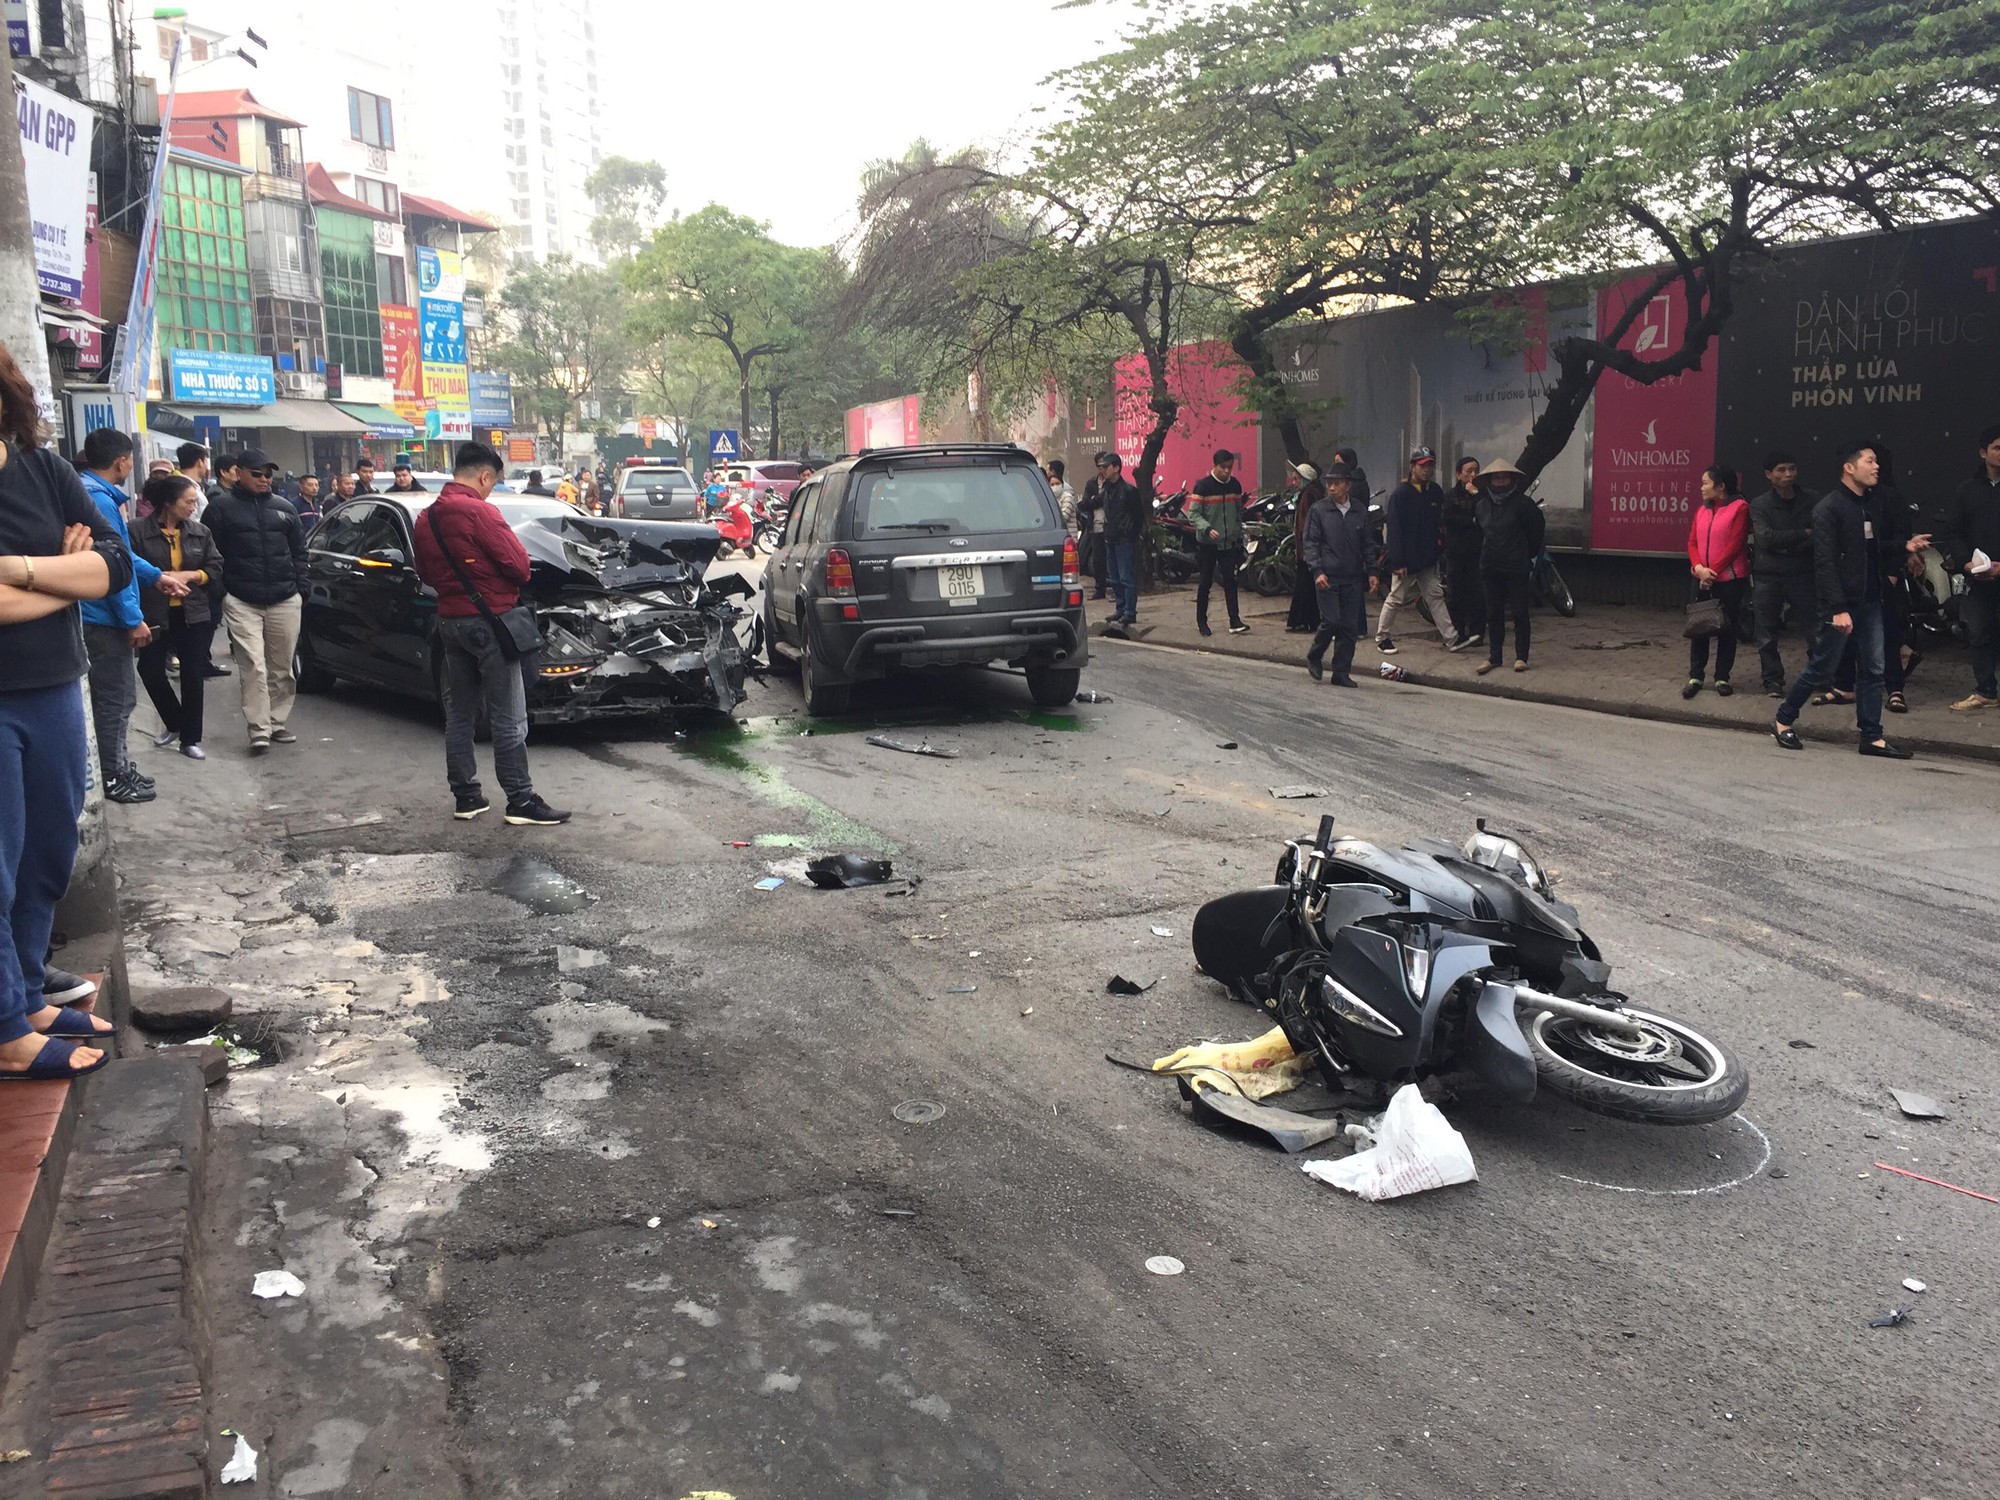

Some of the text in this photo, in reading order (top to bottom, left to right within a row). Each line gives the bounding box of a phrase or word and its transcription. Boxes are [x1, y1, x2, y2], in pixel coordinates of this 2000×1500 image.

[45, 108, 76, 156] GPP
[80, 352, 100, 364] MAI
[181, 370, 269, 392] NHÀ THUỐC SỐ 5
[1279, 368, 1319, 384] INHOMES
[427, 377, 447, 395] THU
[448, 378, 467, 395] MAI
[1863, 383, 1922, 404] VINH
[84, 396, 116, 436] NHÀ
[1611, 448, 1690, 466] VINHOMES
[1610, 481, 1691, 494] HOTLINE
[1610, 496, 1689, 513] 18001036
[1609, 513, 1689, 525] www.vinhomes.vn
[928, 555, 993, 565] ESCAPE
[947, 566, 974, 582] 29U
[948, 581, 976, 596] 0115
